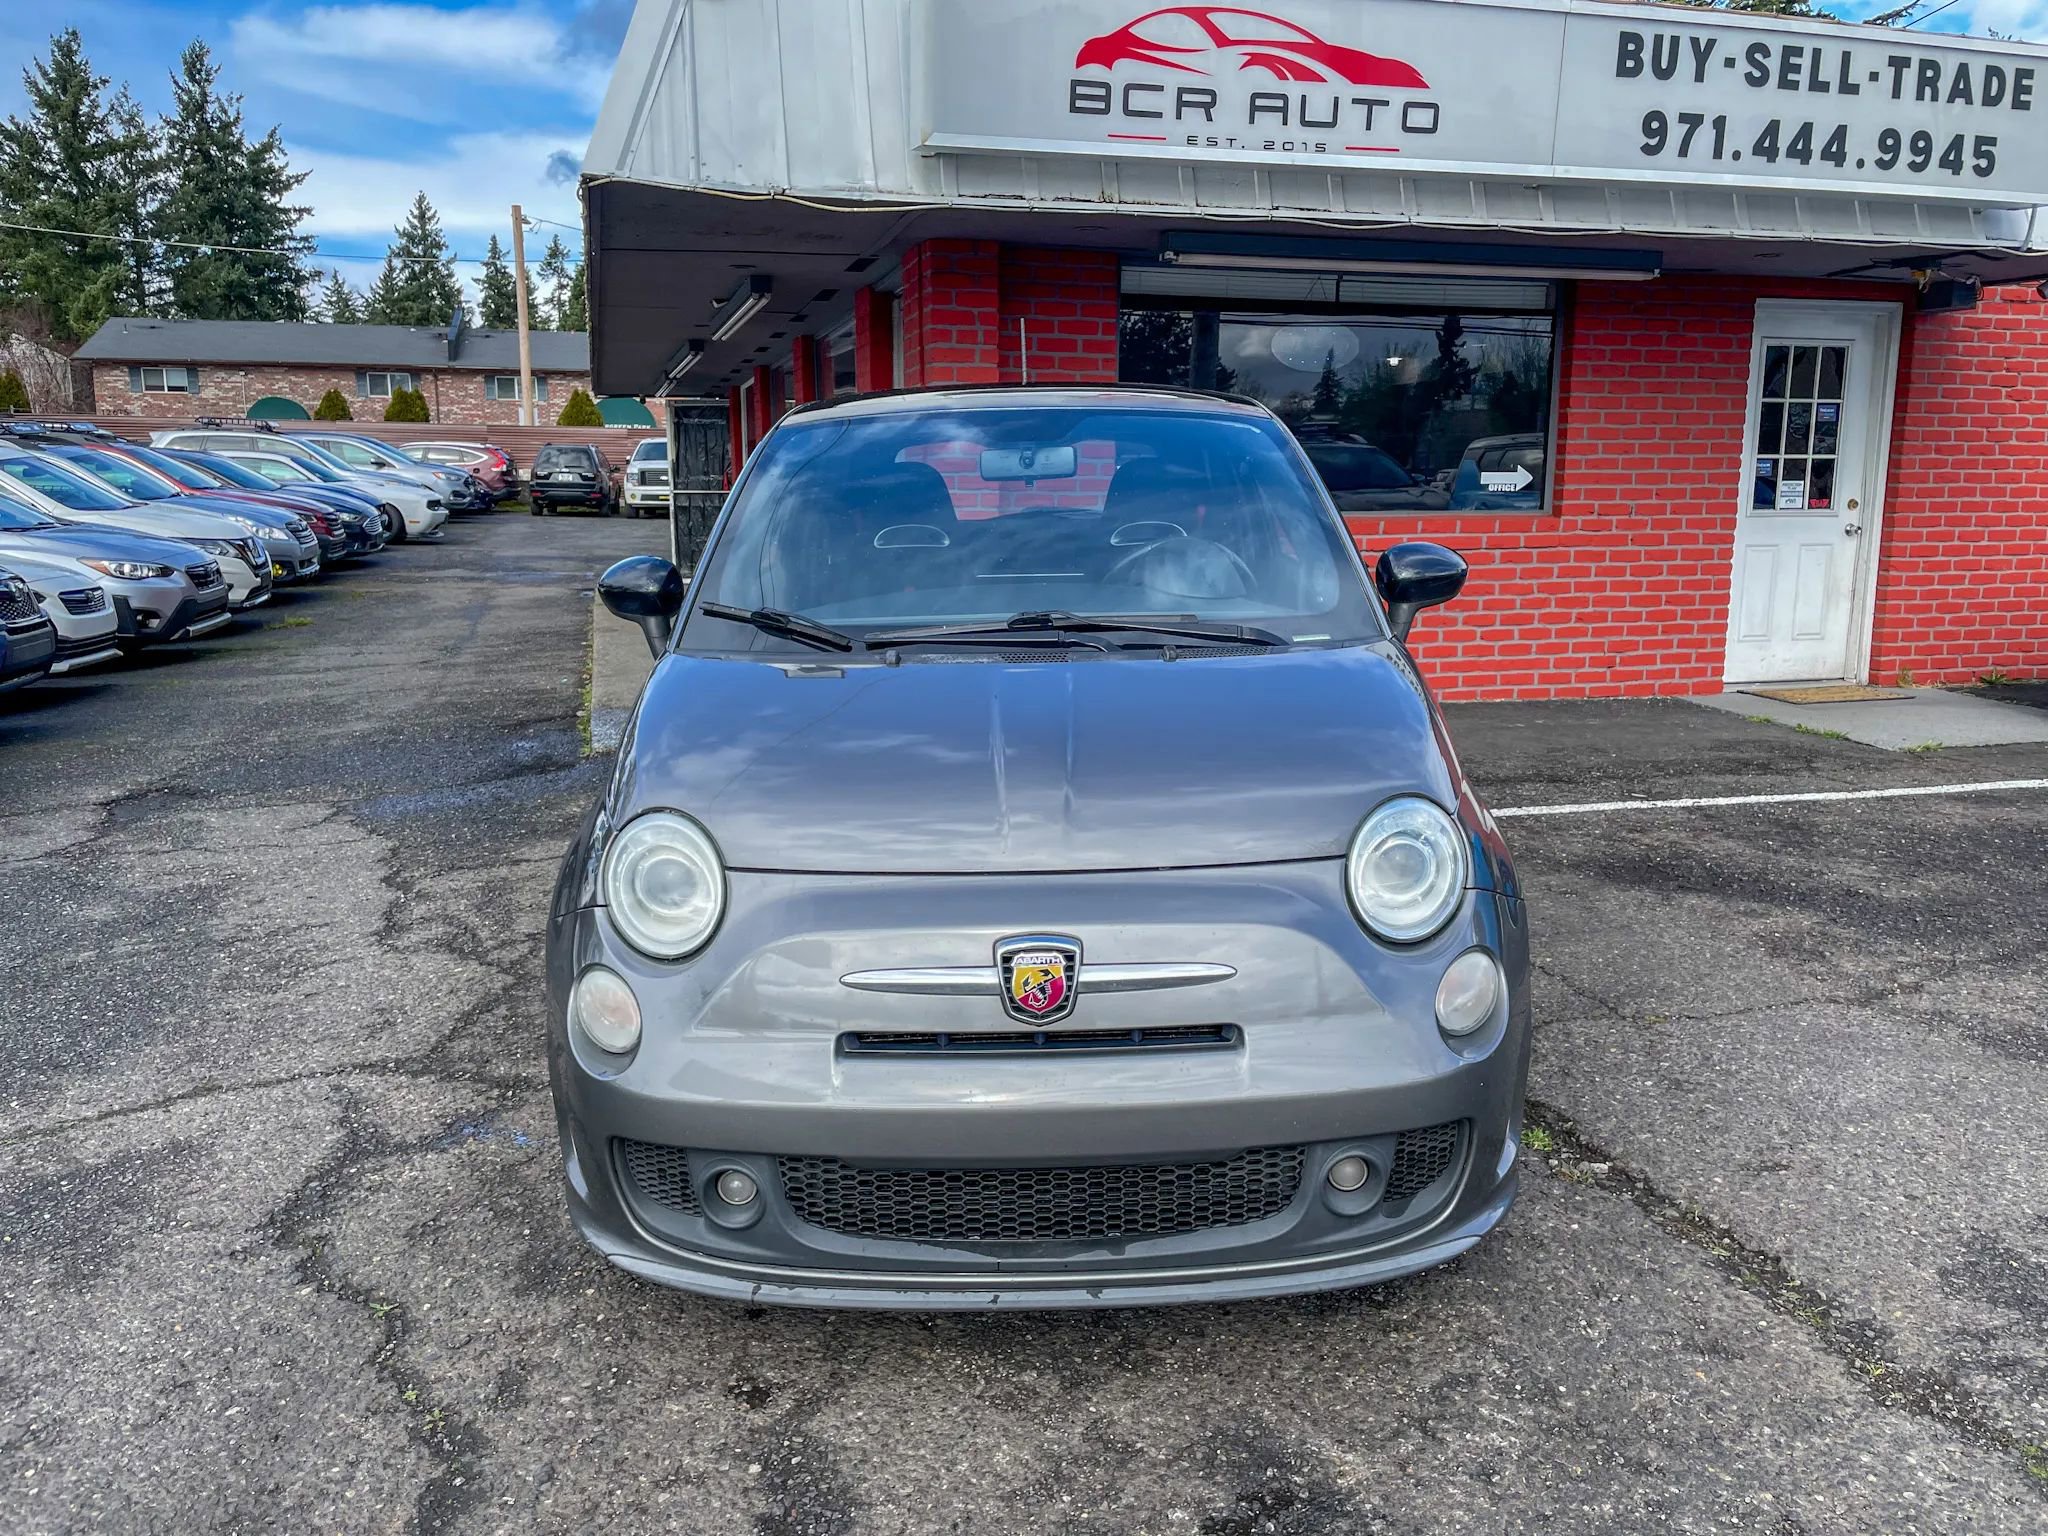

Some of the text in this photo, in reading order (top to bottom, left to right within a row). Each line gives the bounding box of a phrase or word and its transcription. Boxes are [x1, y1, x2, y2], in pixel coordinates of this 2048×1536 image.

[1615, 30, 2036, 112] BUY-SELL-TRADE
[1069, 79, 1440, 134] BCR AUTO
[1186, 135, 1328, 153] EST. 2015
[1639, 109, 1999, 178] 971.444.9945
[1488, 483, 1516, 492] OFFICE
[1016, 956, 1060, 964] ABARTH
